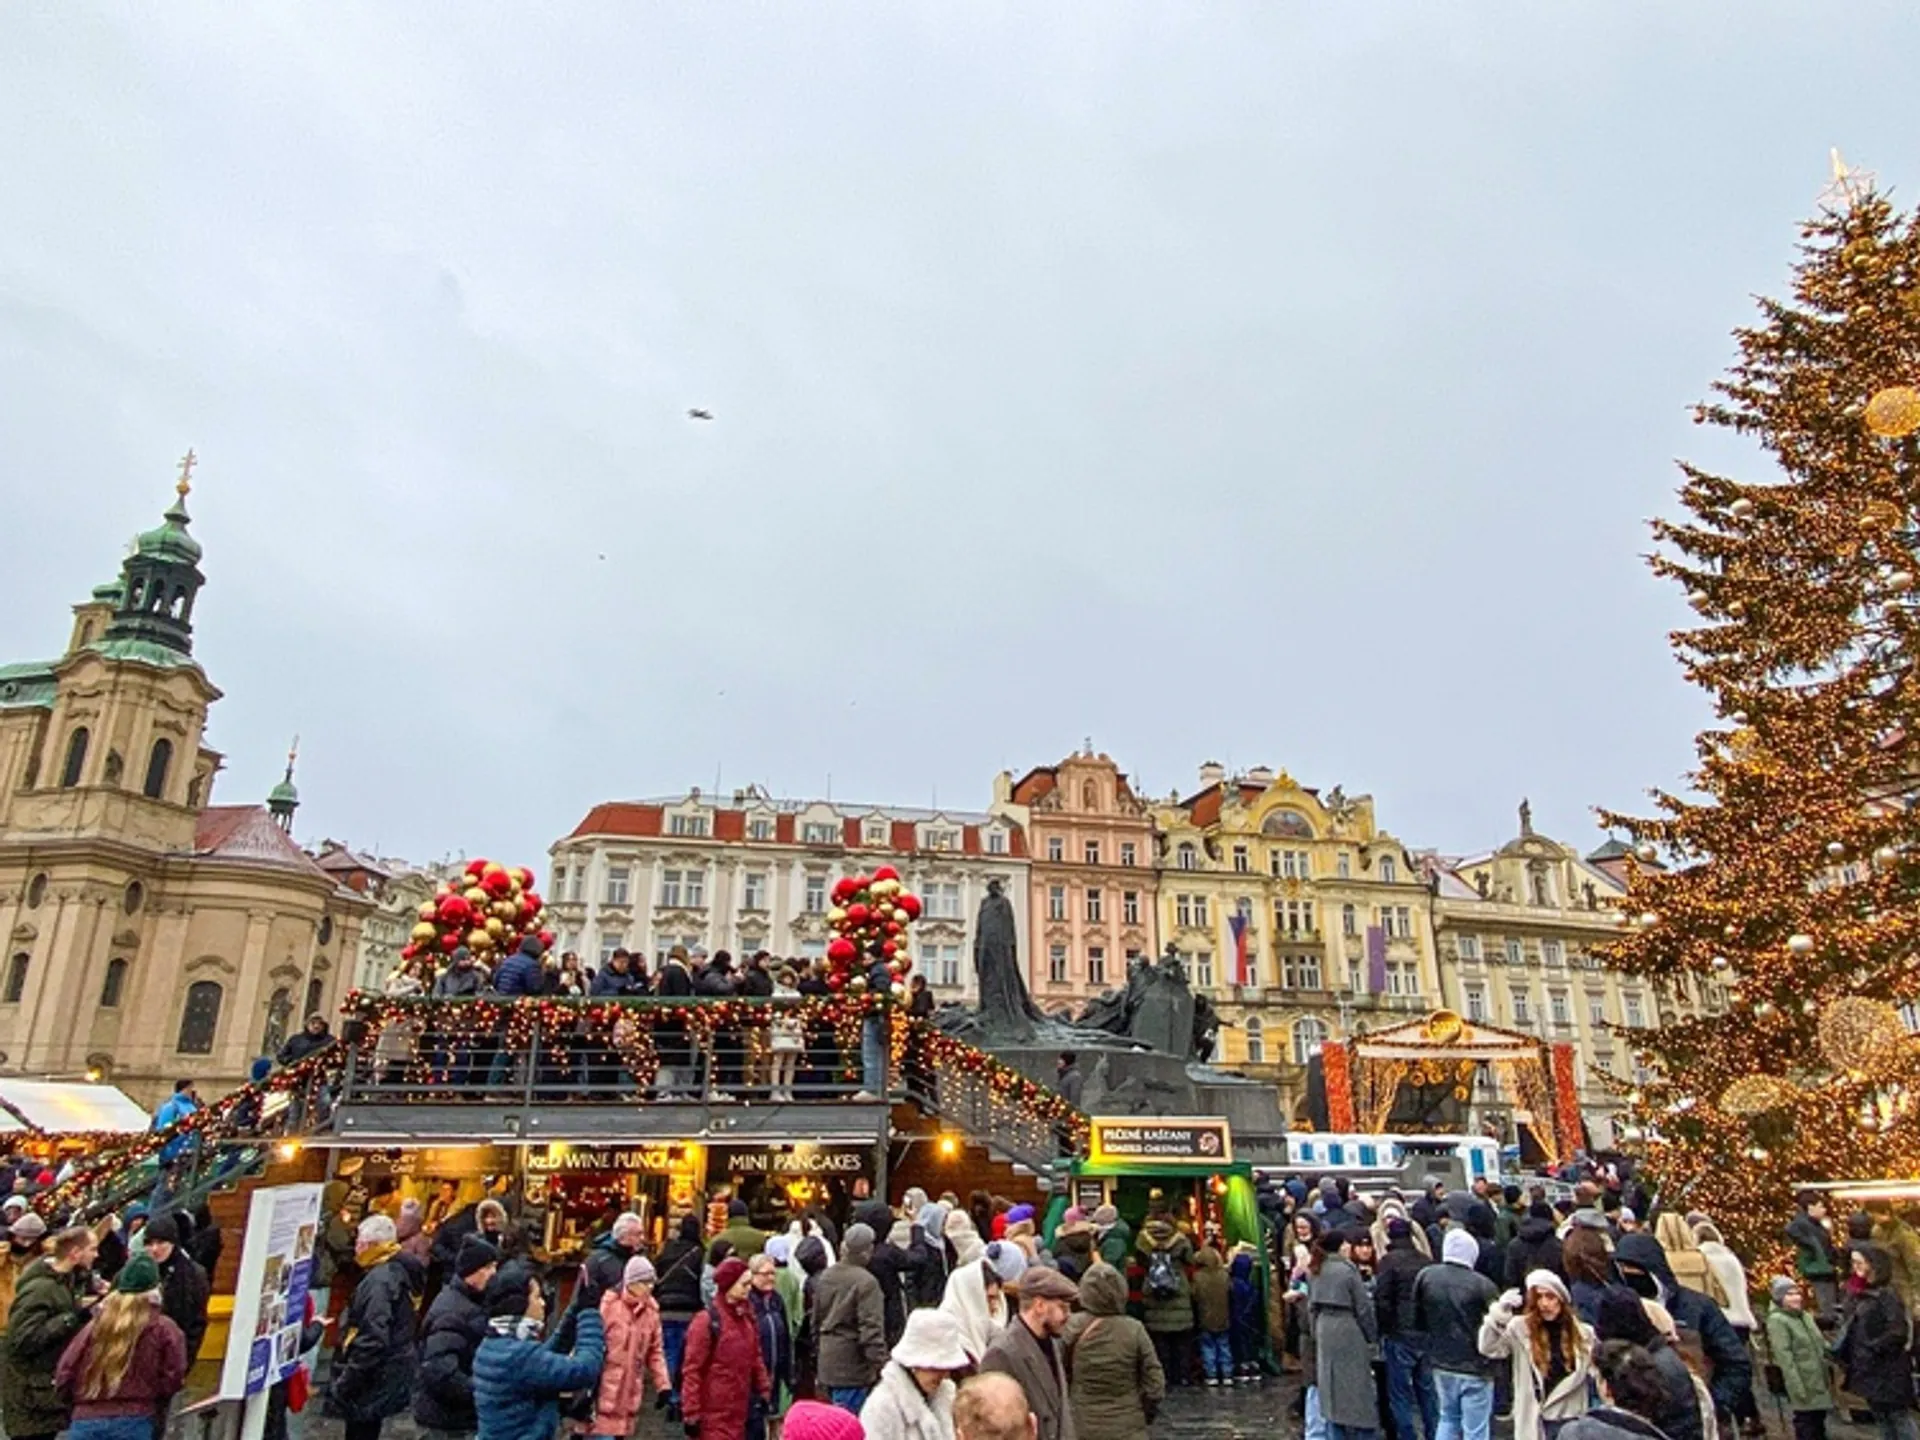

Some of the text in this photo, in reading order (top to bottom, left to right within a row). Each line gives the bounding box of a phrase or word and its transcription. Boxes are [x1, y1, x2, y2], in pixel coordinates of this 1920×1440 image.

[564, 1151, 610, 1168] WINE
[727, 1153, 862, 1171] MINI PANCAKES
